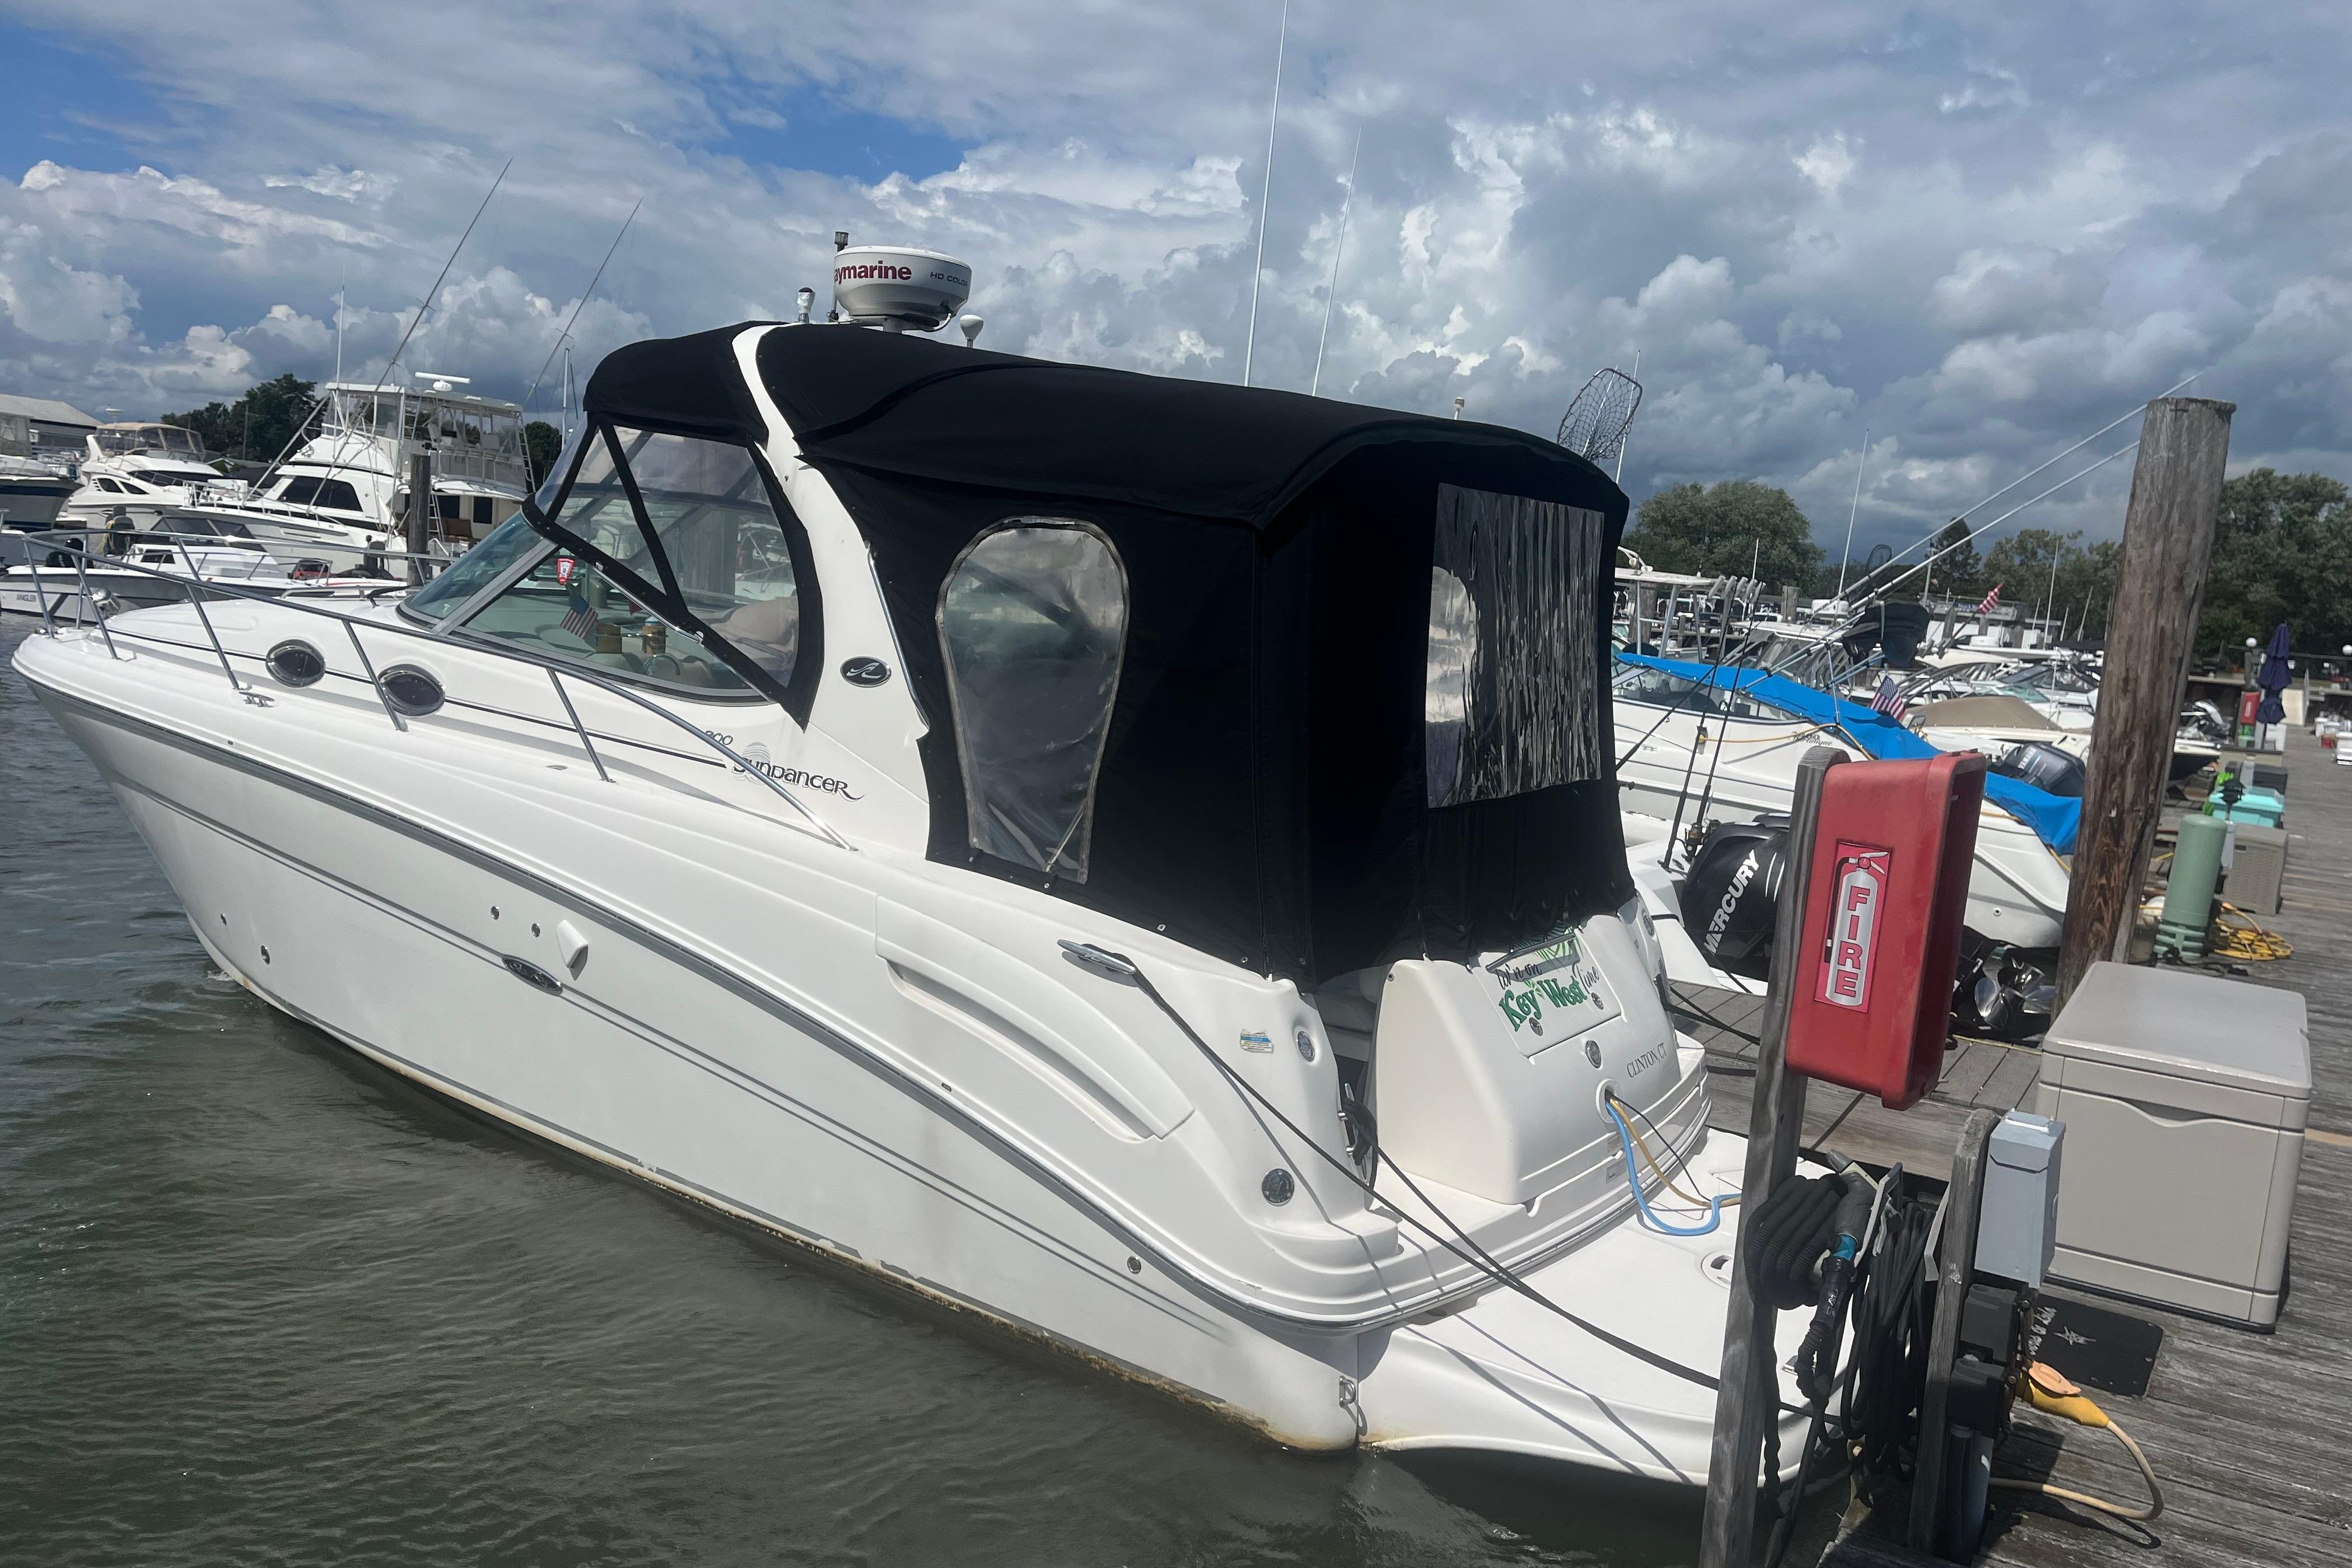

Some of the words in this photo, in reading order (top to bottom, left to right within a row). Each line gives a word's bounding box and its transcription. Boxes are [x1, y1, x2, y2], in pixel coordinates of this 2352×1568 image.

[834, 260, 912, 285] aymarine
[929, 272, 944, 280] HD
[1703, 849, 1759, 954] MERCURY
[1834, 885, 1871, 998] FIRE
[1524, 963, 1543, 976] on
[1498, 989, 1542, 1032] Key
[1536, 978, 1588, 1008] West
[1572, 960, 1600, 995] Time
[1657, 1042, 1667, 1059] CT
